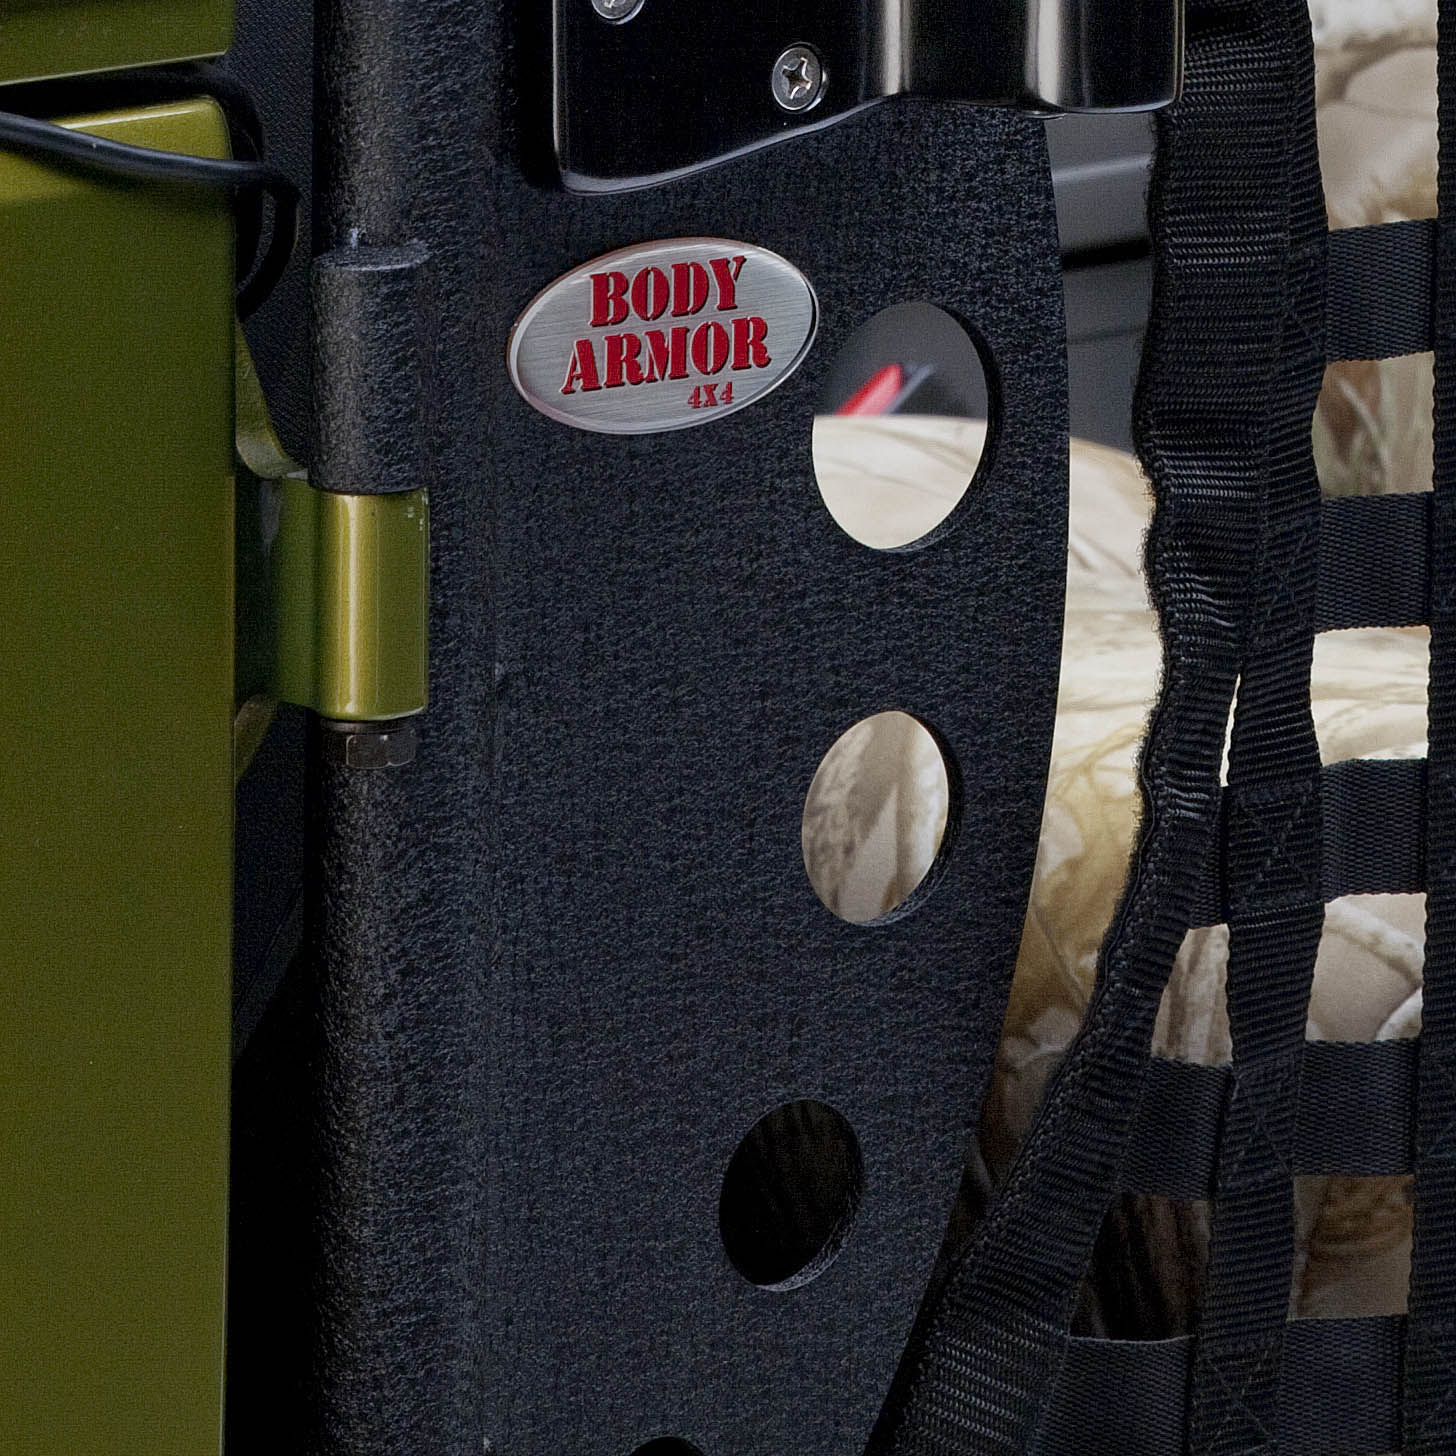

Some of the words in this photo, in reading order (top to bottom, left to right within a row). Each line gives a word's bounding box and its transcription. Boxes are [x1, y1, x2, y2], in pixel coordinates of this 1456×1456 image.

[588, 255, 747, 327] BODY
[560, 316, 772, 395] ARMOR
[687, 381, 735, 409] 4X4
